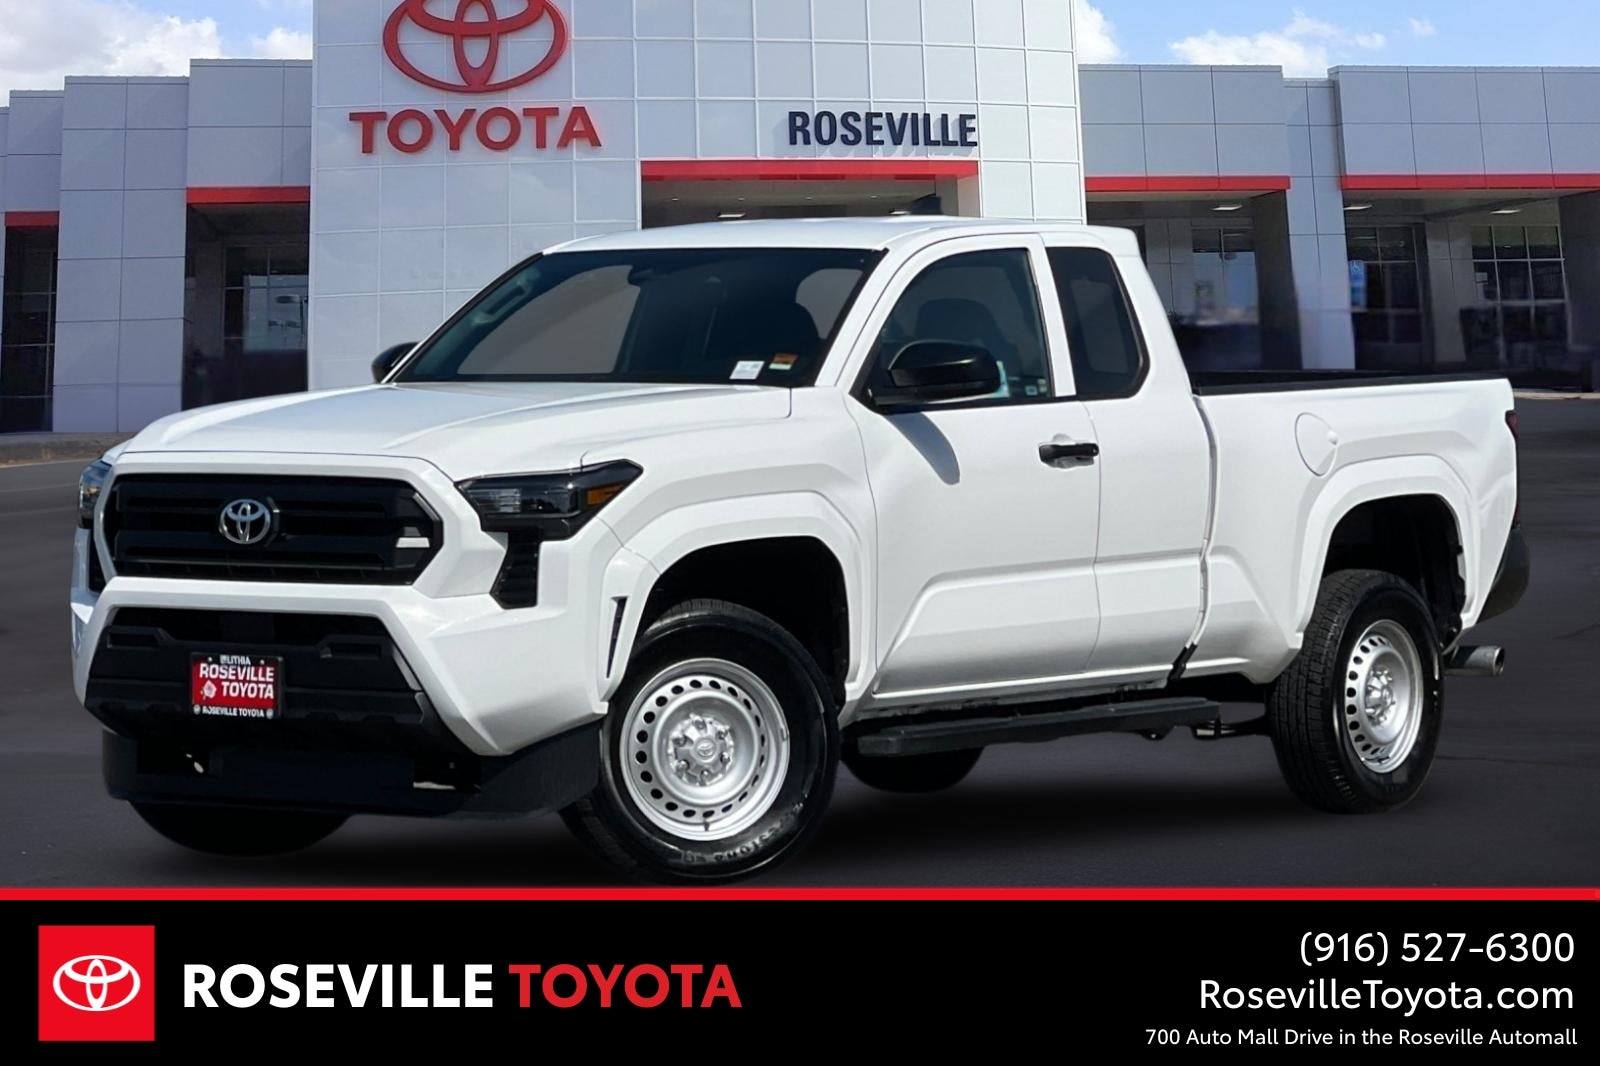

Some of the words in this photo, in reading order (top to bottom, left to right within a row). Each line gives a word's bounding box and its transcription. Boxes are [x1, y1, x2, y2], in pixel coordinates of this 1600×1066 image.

[350, 106, 602, 154] TOYOTA
[788, 110, 978, 147] ROSEVILLE
[199, 663, 274, 682] ROSEVILLE
[221, 681, 274, 699] TOYOTA
[202, 705, 237, 716] ROSEVILLE
[239, 707, 264, 717] TOYOTA
